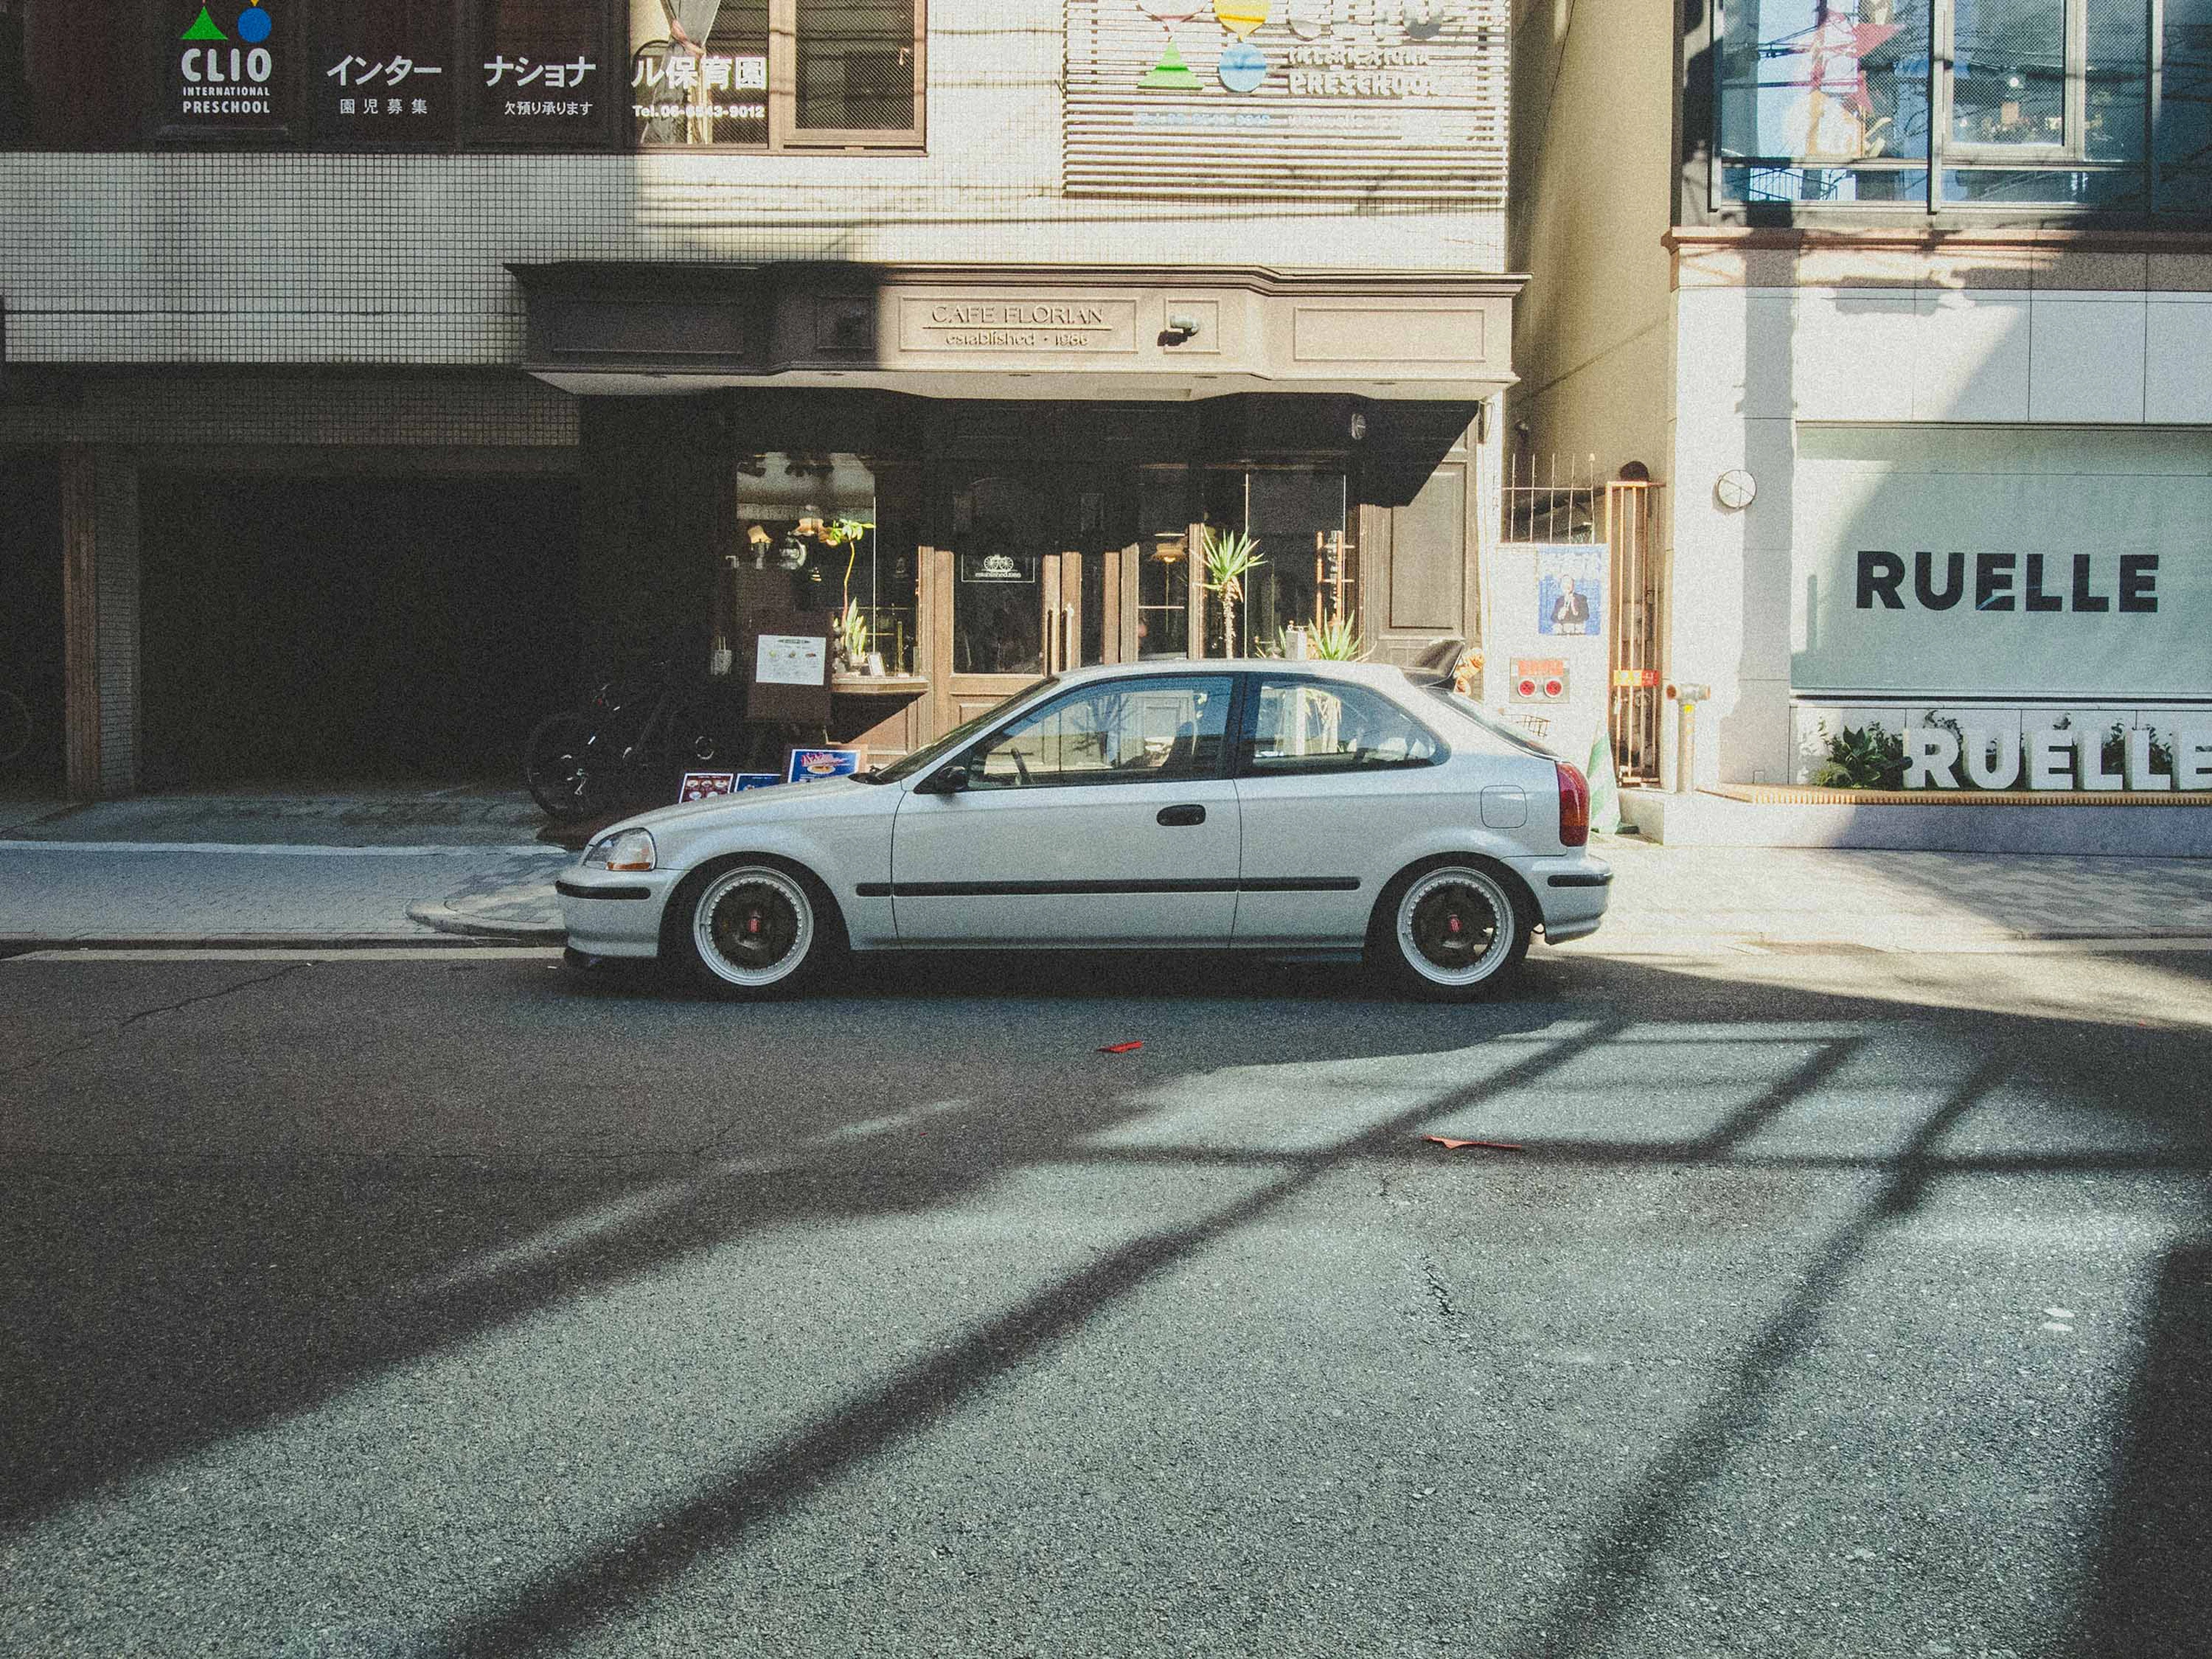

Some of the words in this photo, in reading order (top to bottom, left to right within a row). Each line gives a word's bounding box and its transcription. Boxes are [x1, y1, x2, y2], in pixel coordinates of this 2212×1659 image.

[181, 48, 272, 82] CLIO
[327, 55, 442, 86] インター
[484, 55, 596, 87] ナショナ
[631, 56, 767, 90] ル保育園
[183, 87, 270, 96] INTERNATIONAL
[183, 101, 270, 113] PRESCHOOL
[340, 99, 427, 115] 園児募集
[504, 101, 593, 115] 欠預り承ります
[931, 305, 995, 324] CAFE
[1004, 305, 1104, 324] FLORIAN
[946, 330, 1036, 346] established
[1856, 551, 2159, 613] RUELLE
[1903, 728, 2212, 790] RUELLE
